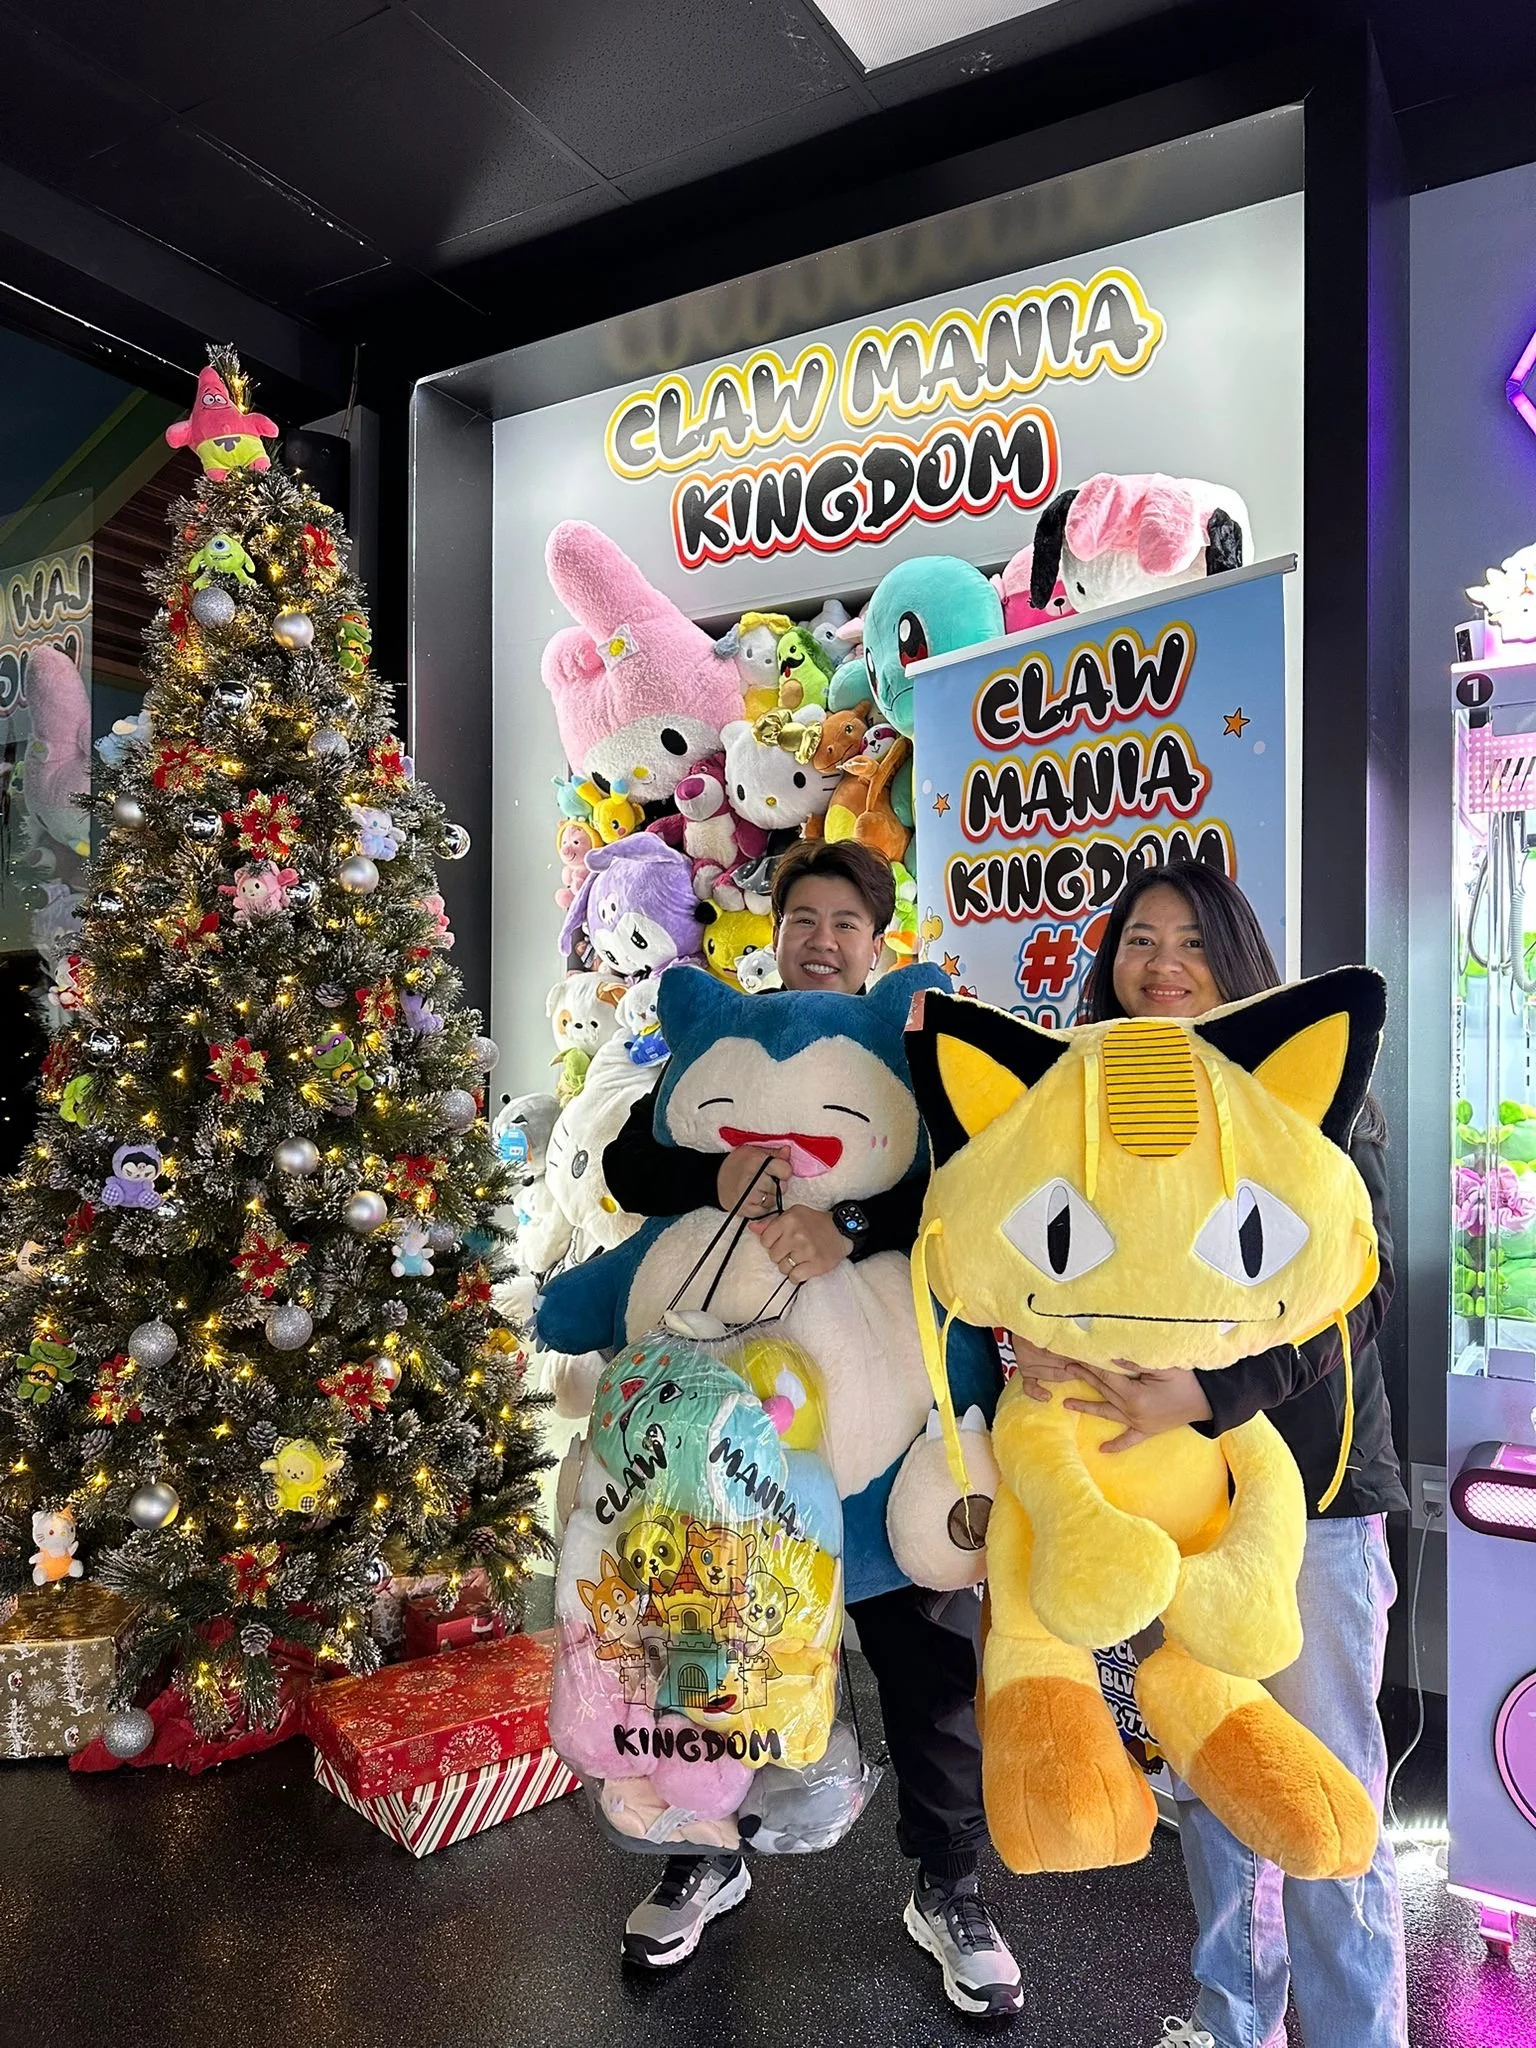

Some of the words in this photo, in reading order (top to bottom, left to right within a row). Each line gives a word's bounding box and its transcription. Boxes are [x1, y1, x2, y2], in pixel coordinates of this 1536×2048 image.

[610, 350, 830, 473] CLAW
[847, 276, 1156, 424] MANIA
[677, 411, 1053, 565] KINGDOM
[977, 626, 1191, 745] CLAW
[1466, 678, 1480, 701] 1
[964, 728, 1206, 837] MANIA
[594, 1438, 669, 1525] CLAW
[708, 1437, 807, 1542] MANIA
[1100, 1664, 1134, 1696] BLV
[613, 1725, 782, 1764] KINGDOM
